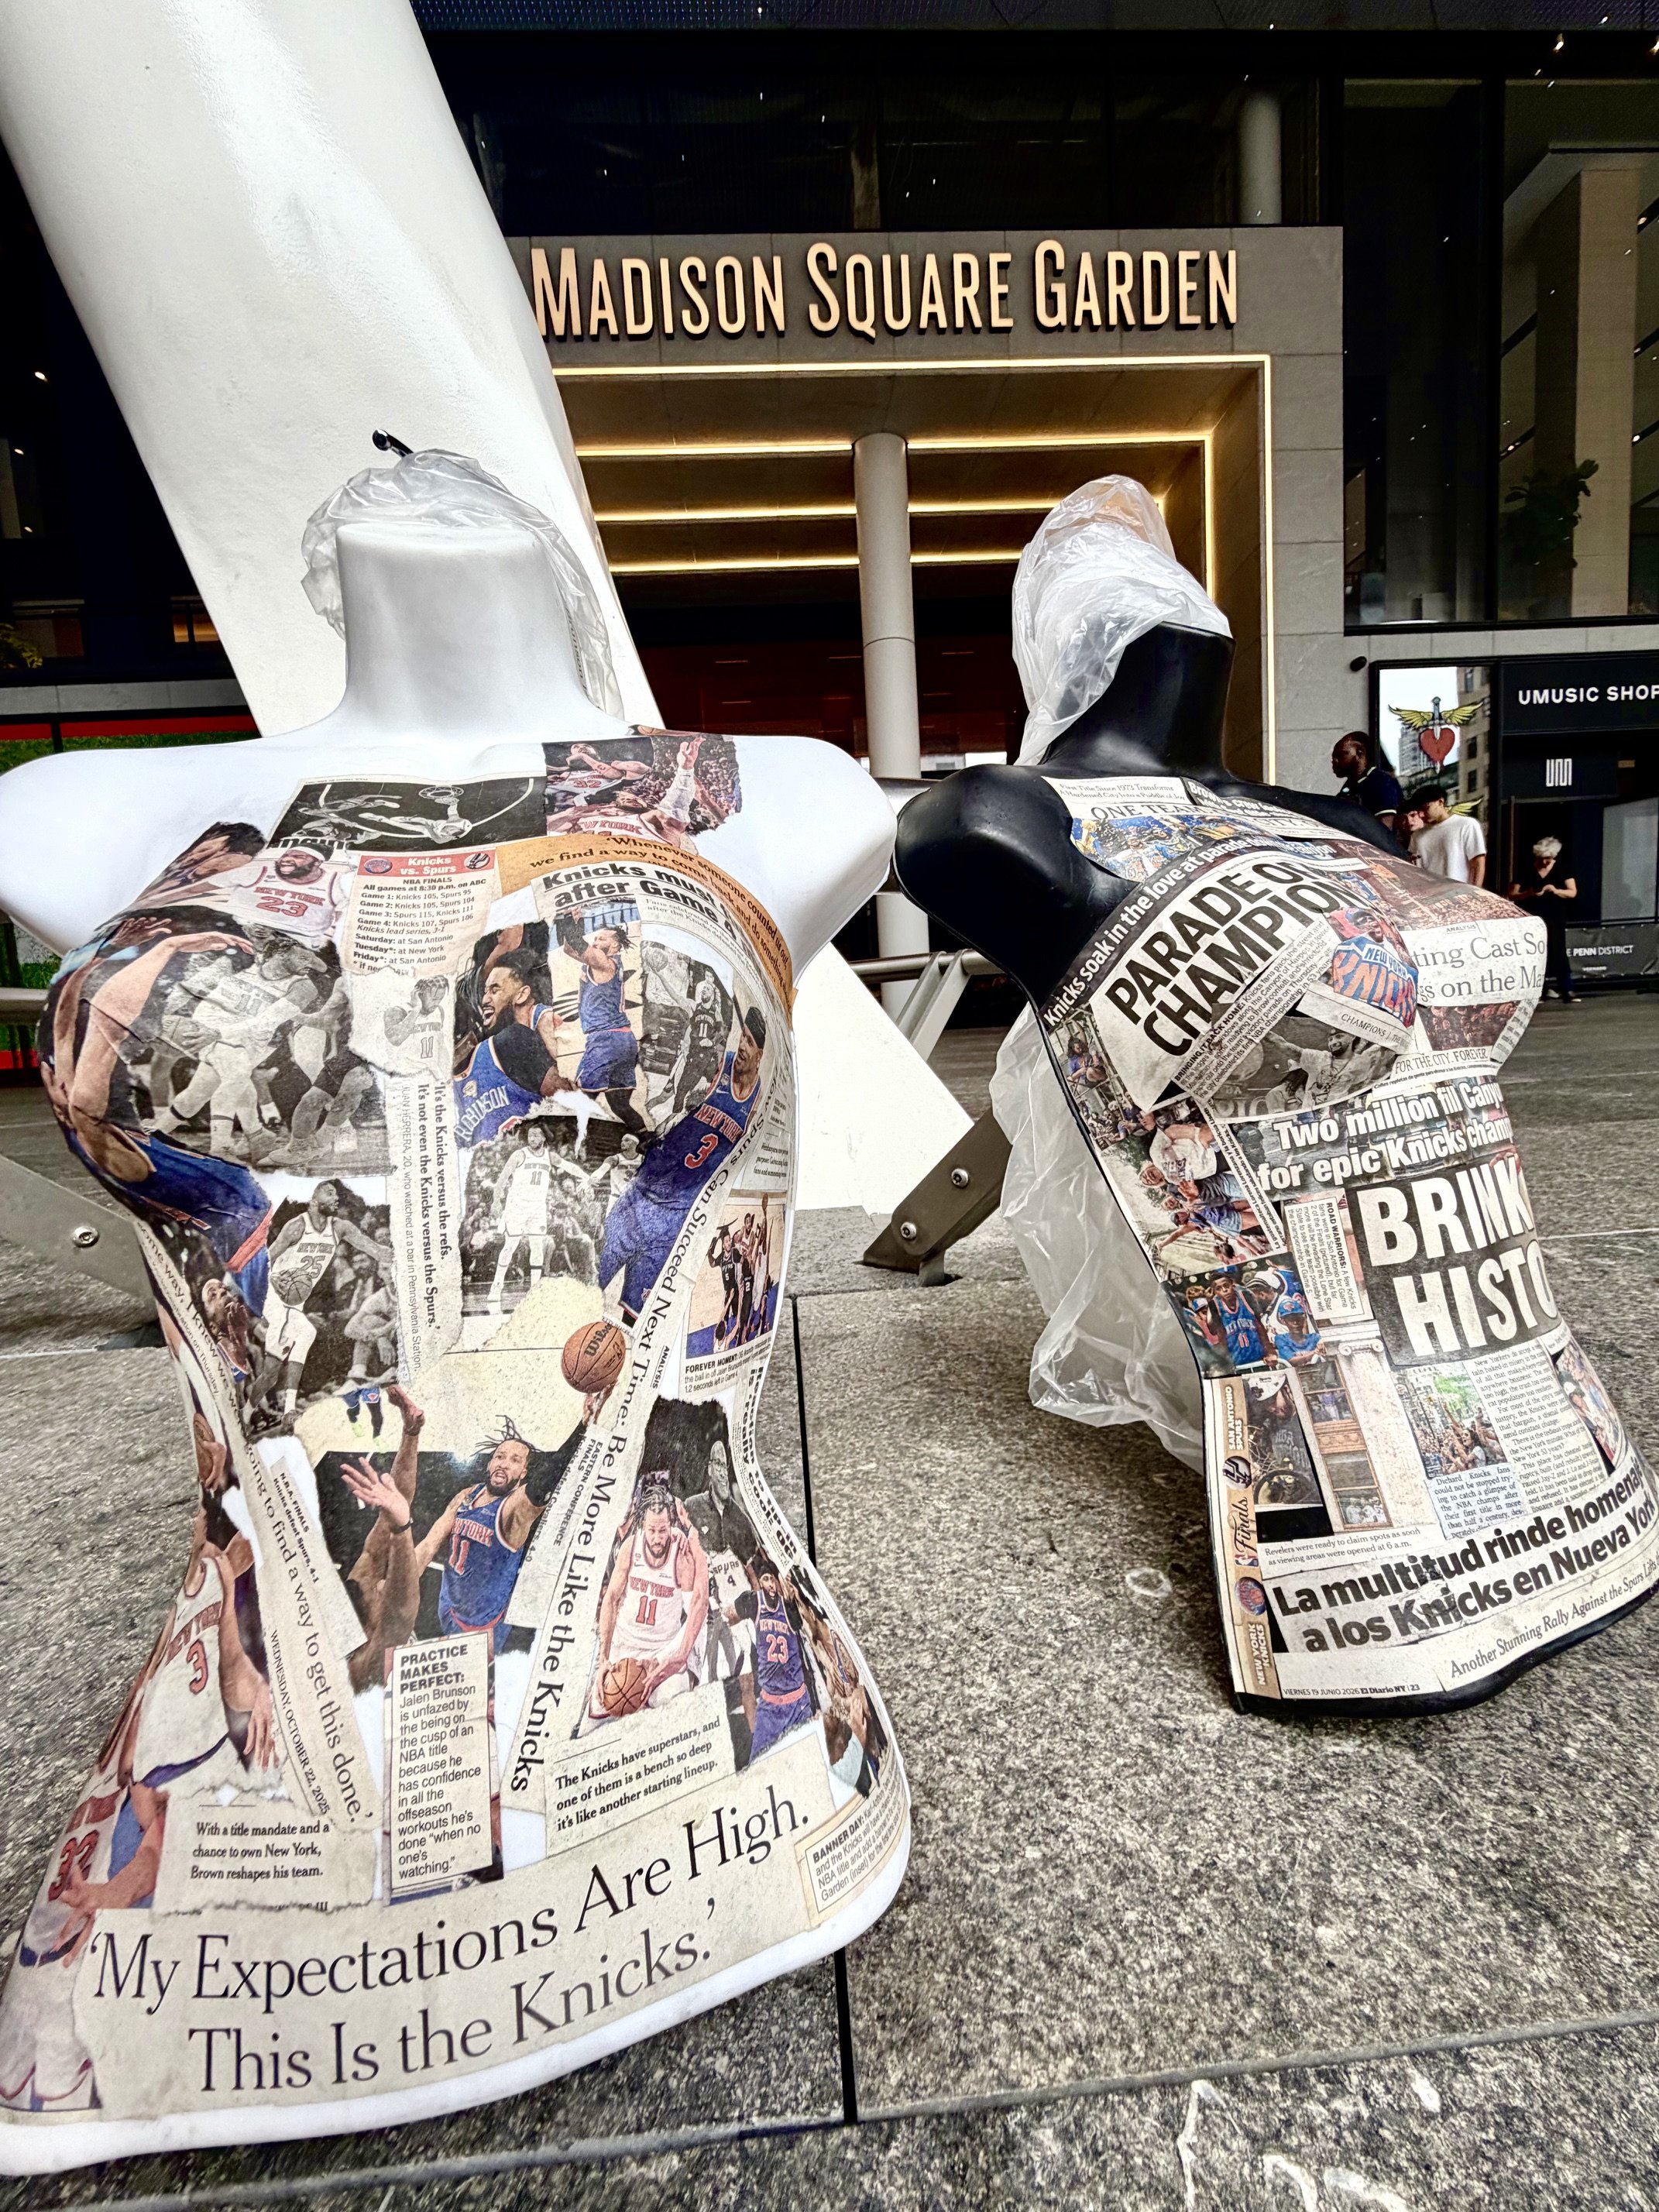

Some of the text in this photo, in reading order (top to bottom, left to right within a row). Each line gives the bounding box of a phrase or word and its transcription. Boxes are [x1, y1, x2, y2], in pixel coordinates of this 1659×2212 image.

[531, 238, 1238, 341] MADISON SQUARE GARDEN
[1519, 687, 1599, 705] UMUSIC
[1091, 805, 1142, 819] ONE
[407, 857, 452, 866] Knicks
[423, 866, 456, 875] Spurs
[530, 857, 555, 868] we
[559, 848, 593, 861] find
[612, 849, 647, 857] way
[652, 853, 668, 861] to
[542, 863, 716, 907] Knicks must
[554, 880, 719, 922] after Game
[698, 859, 746, 902] someone
[747, 900, 777, 940] counted
[256, 896, 308, 917] 23
[1043, 977, 1086, 1027] Knicks
[1080, 940, 1116, 982] soak
[1104, 923, 1129, 945] in
[1120, 896, 1154, 926] the
[1143, 867, 1186, 901] love
[1180, 857, 1205, 874] at
[1203, 836, 1246, 863] parade
[1104, 872, 1273, 1025] PARADE
[1471, 936, 1524, 960] Cast
[1573, 947, 1596, 957] PENN
[1598, 945, 1633, 955] DISTRICT
[1143, 881, 1380, 1056] CHAMPION
[1441, 968, 1516, 998] on the
[1340, 1013, 1386, 1038] CHAMPIONS
[1395, 1059, 1413, 1074] FOR
[1413, 1055, 1431, 1070] THE
[434, 1105, 446, 1123] the
[1273, 1118, 1340, 1150] Two
[1346, 1094, 1440, 1138] million
[1436, 1085, 1463, 1115] fill
[435, 1125, 448, 1166] Knicks
[685, 1133, 719, 1170] 3
[1257, 1163, 1305, 1193] for
[1313, 1149, 1381, 1185] epic
[1384, 1126, 1468, 1169] Knicks
[437, 1169, 447, 1207] versus
[439, 1210, 450, 1230] the
[1356, 1155, 1534, 1268] BRINK
[439, 1235, 452, 1260] refs.
[1326, 1202, 1347, 1269] ROAD WARRIORS:
[1393, 1239, 1558, 1358] HISTO
[652, 1345, 670, 1389] ANALYSIS
[685, 1361, 715, 1374] FOREVER
[1225, 1386, 1235, 1429] ANTONIO
[509, 1114, 764, 1794] Spurs Can Succeed Next Time: Be More Like the Knicks
[578, 1438, 596, 1472] FINALS
[1235, 1419, 1244, 1450] SPURS
[263, 1497, 275, 1519] to
[280, 1472, 310, 1533] N.B.A. FINALS
[553, 1441, 603, 1547] EASTERN CONFERENCE
[272, 1520, 297, 1564] find
[1231, 1496, 1258, 1553] Finals
[1265, 1546, 1295, 1556] Revelers
[1296, 1543, 1313, 1551] were
[1314, 1539, 1335, 1549] ready
[1347, 1534, 1369, 1544] claim
[1370, 1532, 1391, 1543] spots
[1402, 1527, 1420, 1537] soon
[288, 1567, 299, 1582] a
[448, 1534, 469, 1575] 11
[1272, 1585, 1321, 1617] La
[1321, 1540, 1489, 1607] multitud
[1483, 1515, 1566, 1565] rinde
[294, 1582, 314, 1628] way
[635, 1595, 658, 1626] 11
[1301, 1627, 1328, 1653] a
[1325, 1612, 1392, 1648] los
[1388, 1578, 1514, 1638] Knicks
[1513, 1568, 1553, 1596] en
[1547, 1529, 1637, 1586] Nueva
[305, 1631, 321, 1657] to
[1449, 1645, 1498, 1679] Another
[1496, 1627, 1543, 1658] Stunning
[1543, 1610, 1570, 1637] Rally
[1571, 1592, 1609, 1622] Against
[1609, 1585, 1623, 1602] the
[1623, 1571, 1644, 1592] Spurs
[186, 1639, 209, 1695] 3
[400, 1644, 469, 1667] PRACTICE
[766, 1634, 788, 1664] 23
[306, 1661, 331, 1700] get
[400, 1661, 449, 1681] MAKES
[400, 1672, 465, 1695] PERFECT:
[400, 1684, 476, 1709] Jalen Brunson
[270, 1630, 331, 1816] WEDNESDAY, OCTOBER 22, 2025
[319, 1700, 344, 1750] this
[555, 1716, 720, 1791] The Knicks have superstars, and
[575, 1807, 597, 1824] like
[599, 1790, 641, 1815] another
[643, 1773, 682, 1797] starting
[684, 1759, 719, 1780] lineup.
[197, 1822, 220, 1836] With
[231, 1822, 249, 1836] title
[251, 1822, 297, 1836] mandate
[300, 1820, 321, 1833] and
[322, 1824, 330, 1832] a
[812, 1815, 864, 1863] BANNER DAY:
[192, 1905, 558, 2014] Expectations
[573, 1858, 672, 1934] Are
[682, 1784, 810, 1881] High.
[188, 2026, 313, 2091] This
[330, 2021, 380, 2085] Is
[398, 2008, 493, 2074] the
